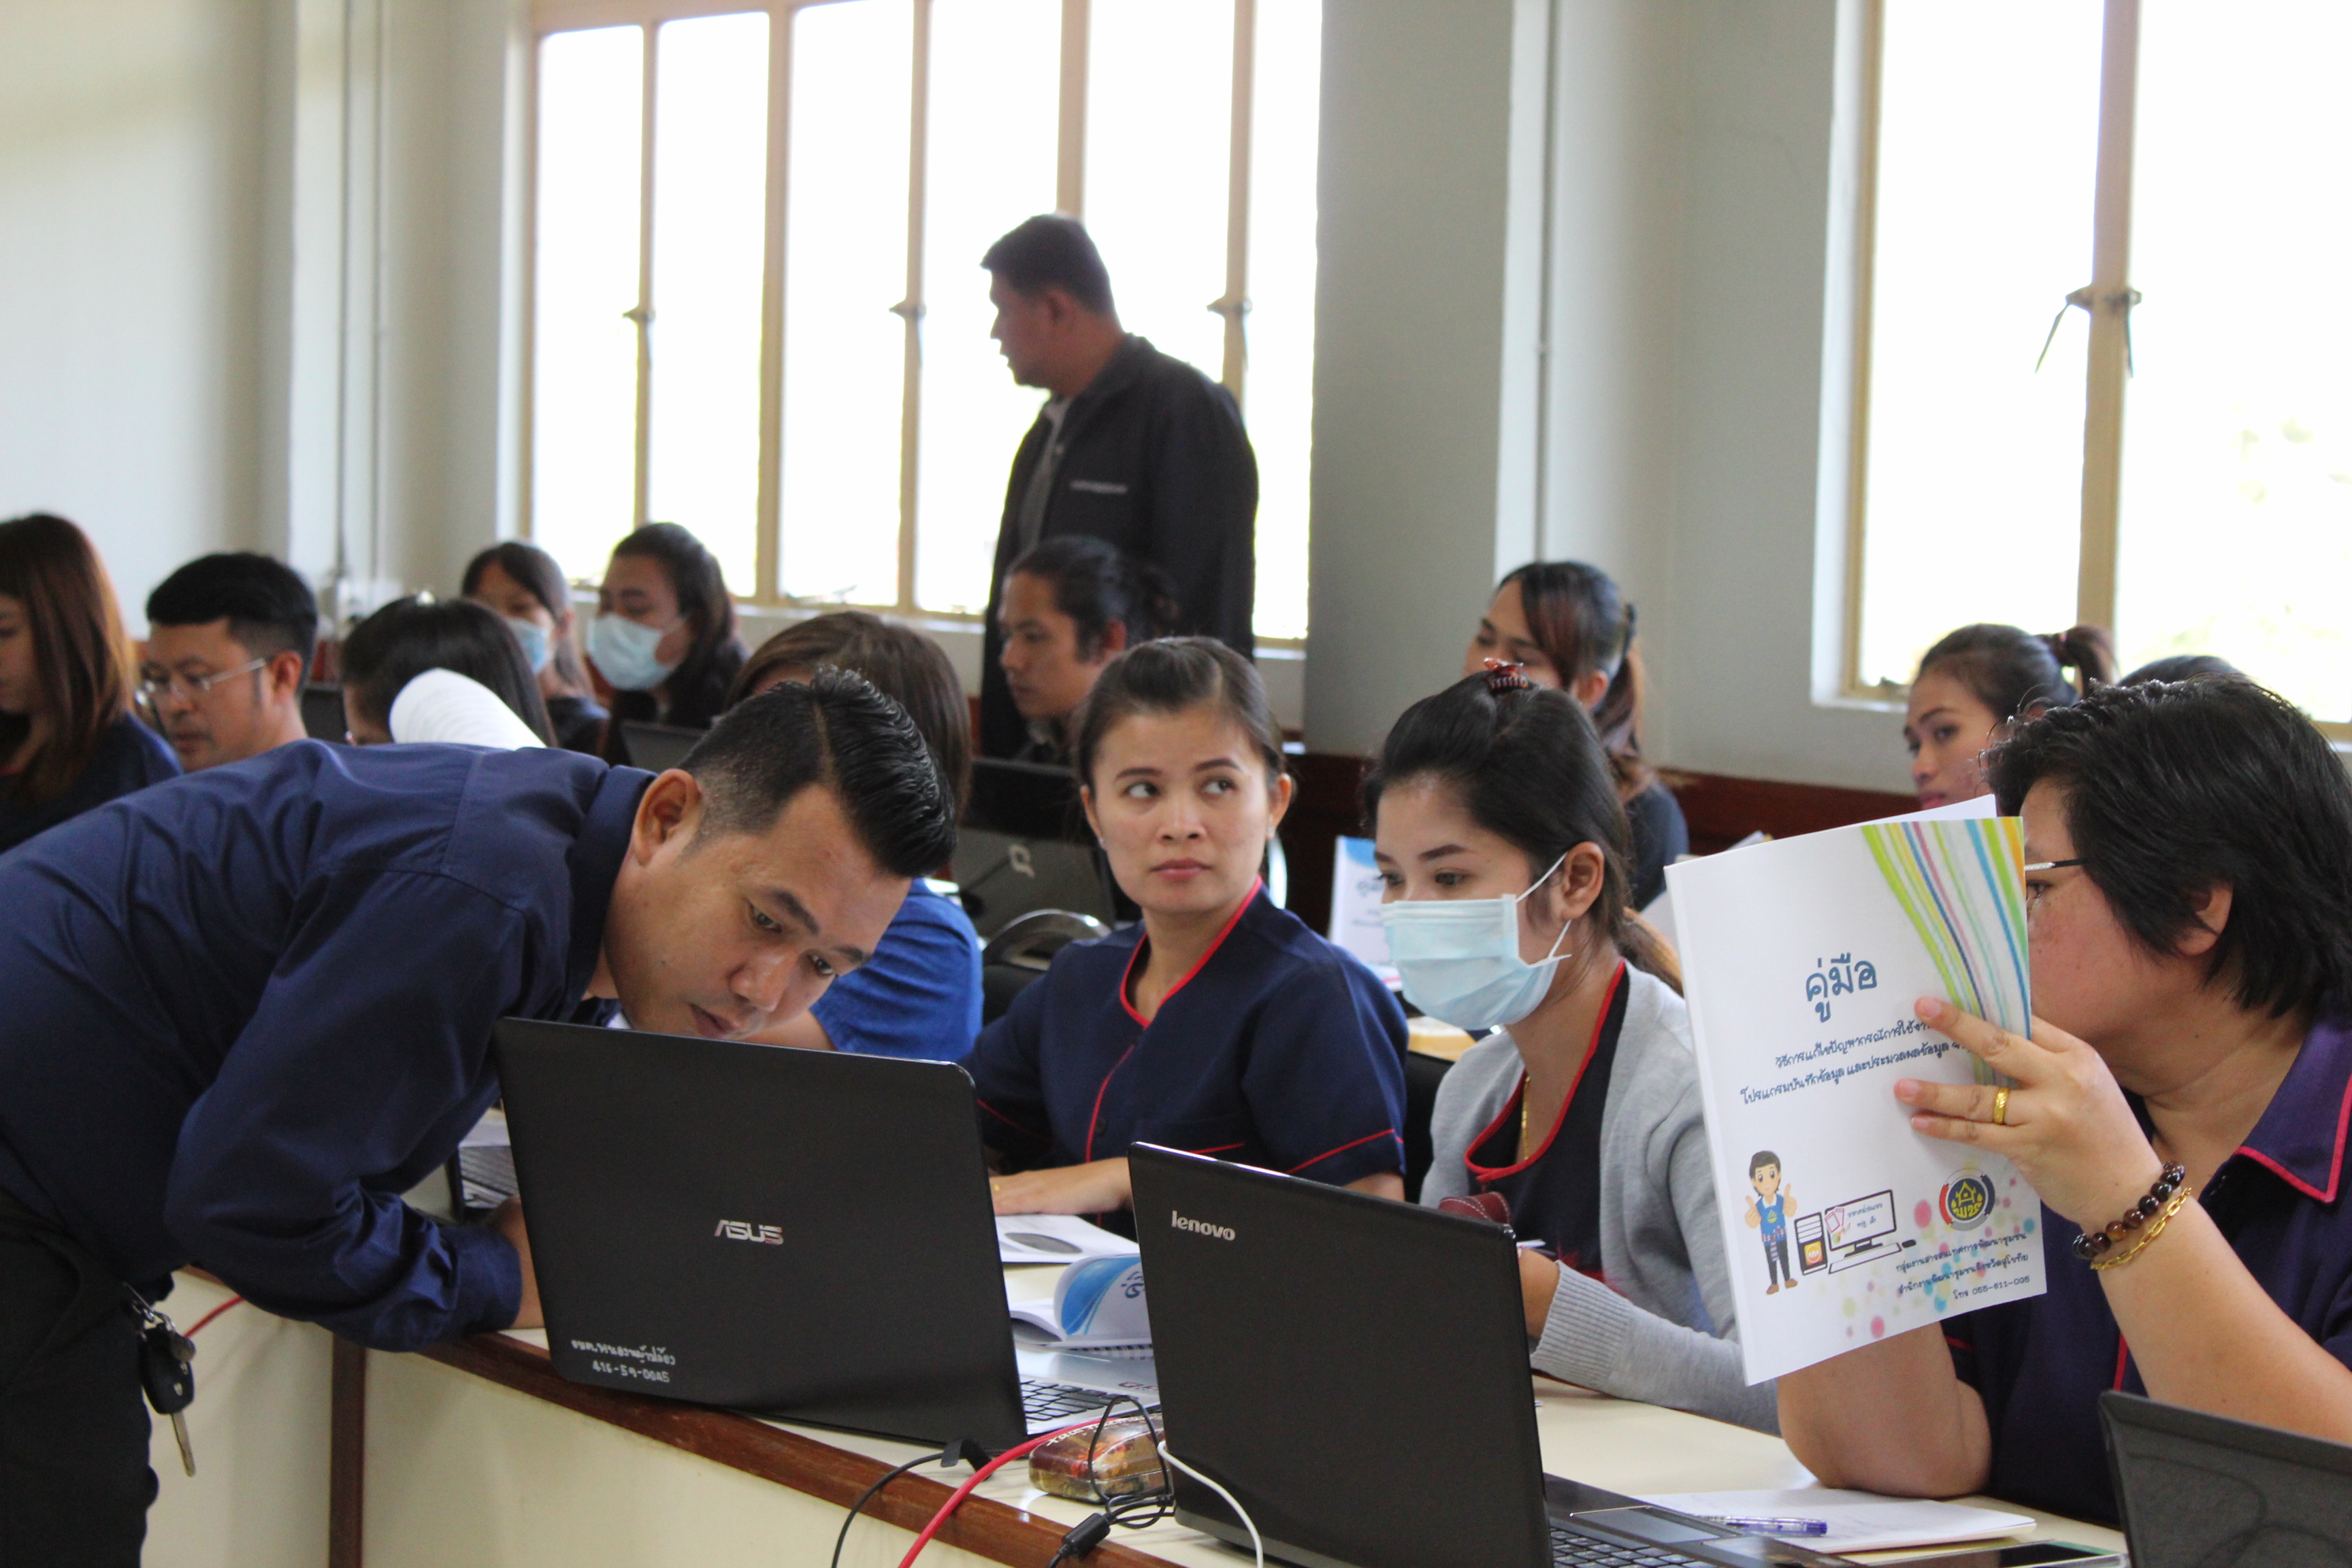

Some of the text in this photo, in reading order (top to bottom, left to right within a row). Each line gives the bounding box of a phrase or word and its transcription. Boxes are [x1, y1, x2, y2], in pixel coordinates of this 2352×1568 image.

[1806, 951, 1877, 1023] คู่มือ
[1775, 1019, 1931, 1068] วิธีการแก้ไขปัญหากรณีการใช้งา
[715, 1220, 784, 1245] ASUS
[1171, 1210, 1236, 1241] lenovo
